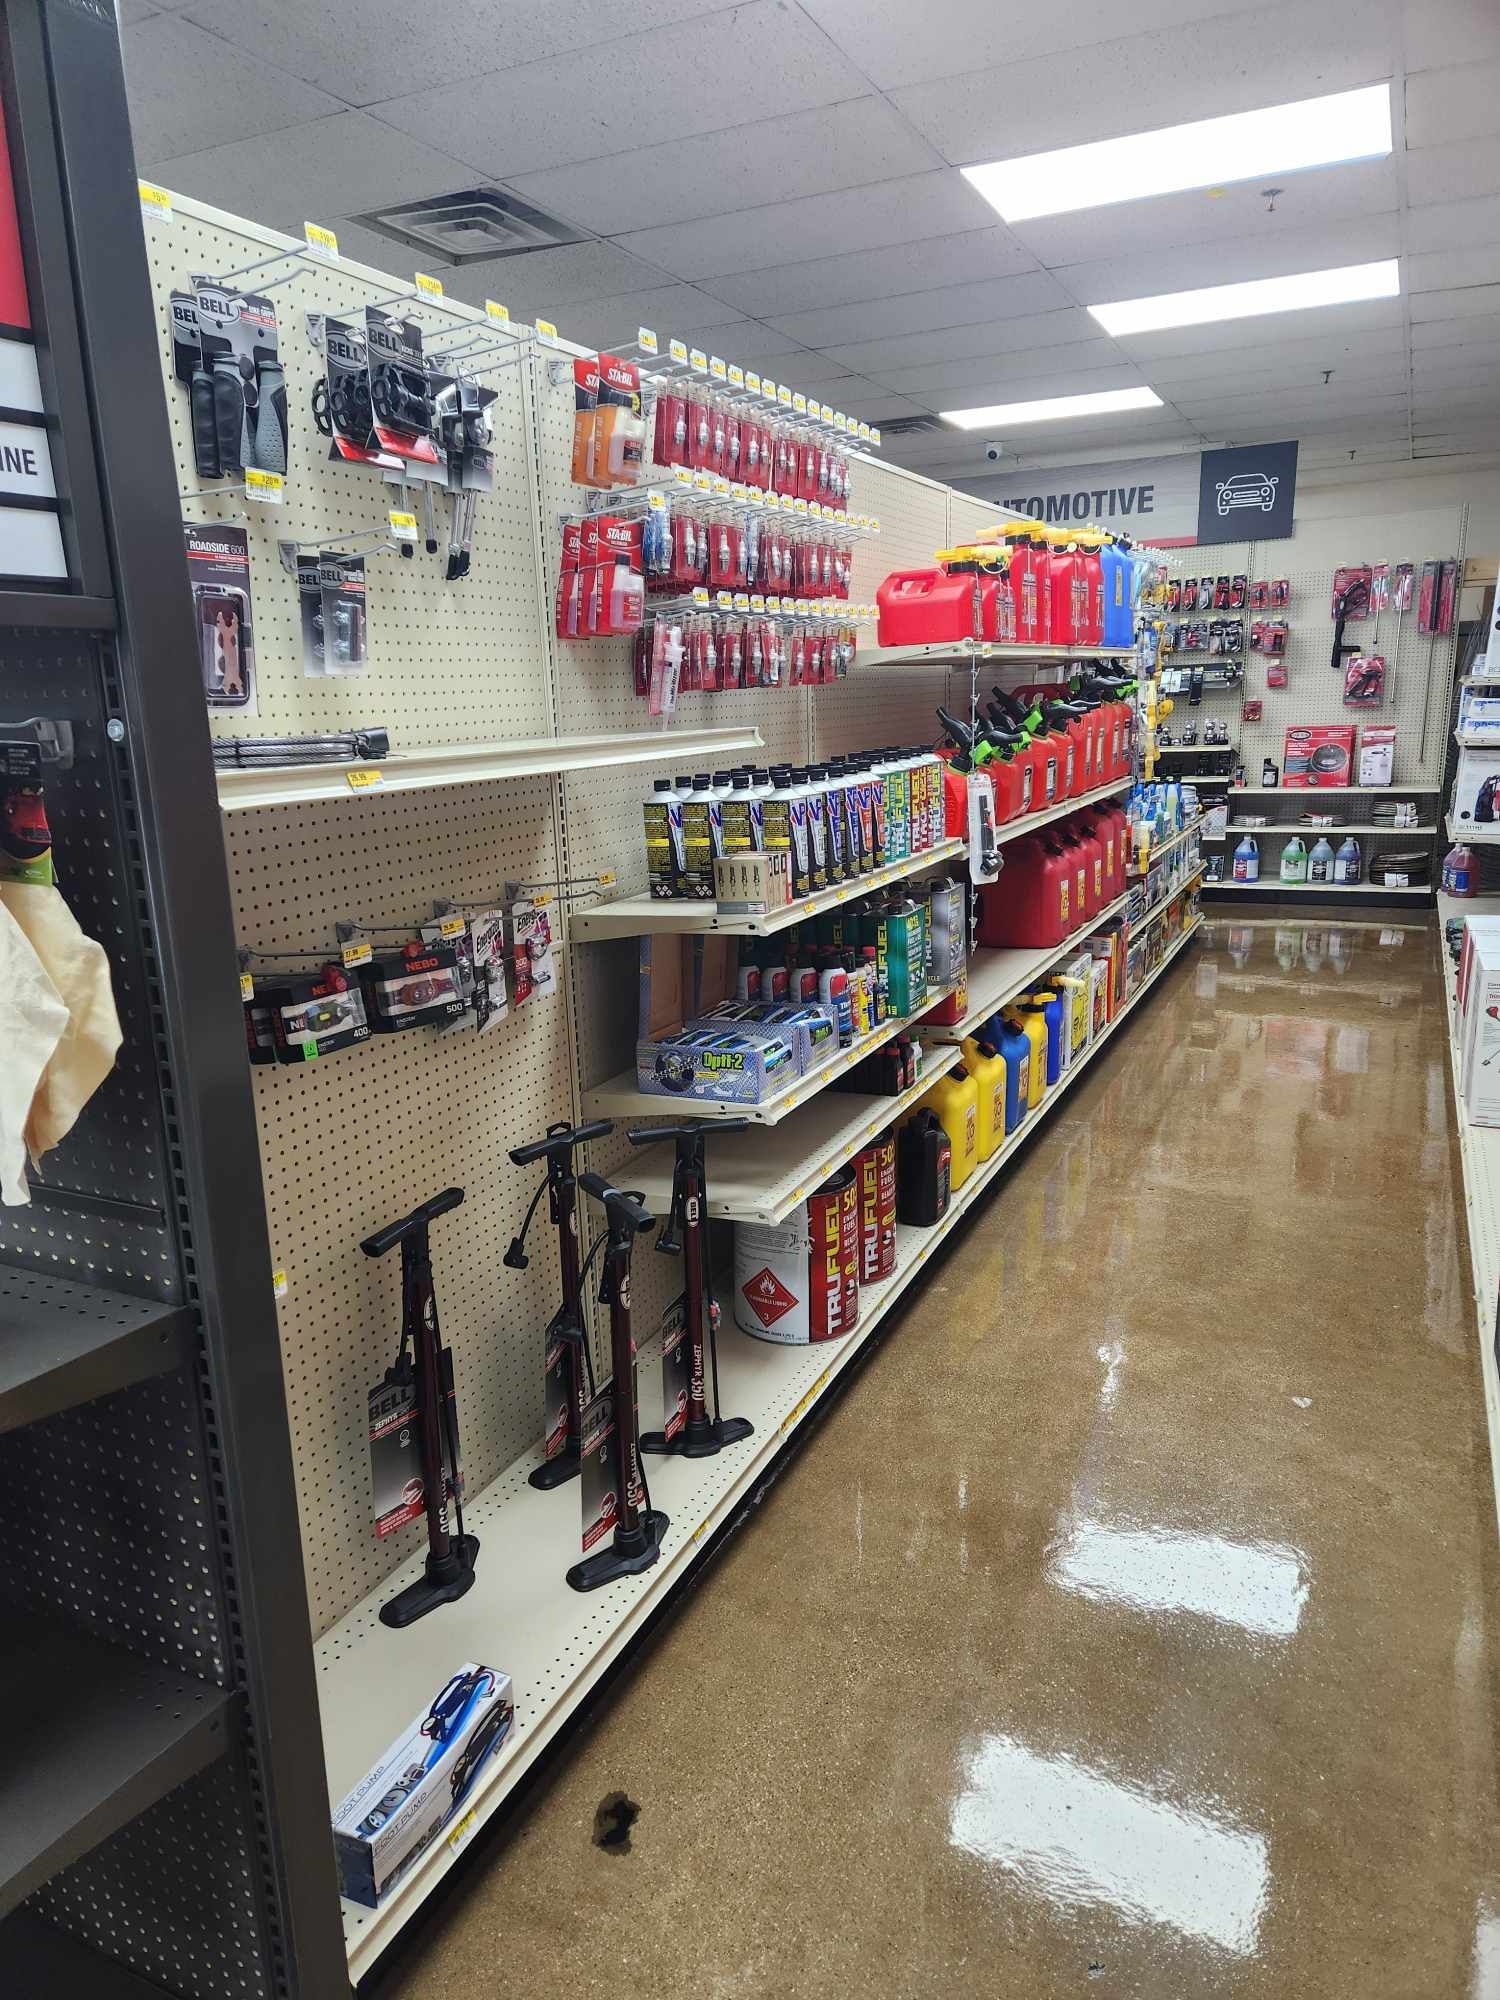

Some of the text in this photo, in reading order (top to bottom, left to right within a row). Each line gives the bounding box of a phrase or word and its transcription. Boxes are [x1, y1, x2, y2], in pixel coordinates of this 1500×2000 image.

[173, 305, 199, 325] BEL
[198, 296, 234, 317] BELL
[327, 339, 359, 361] BELL
[368, 328, 400, 353] BELL
[994, 485, 1155, 522] TOMOTIVE
[189, 540, 230, 554] ROADSIDE
[299, 574, 320, 586] BEL
[320, 570, 343, 582] BELL
[858, 787, 872, 809] VP
[791, 802, 806, 827] VP
[405, 958, 439, 972] NEBO
[446, 1002, 463, 1013] 500
[353, 1026, 369, 1038] 400
[703, 1051, 744, 1072] Opti-2
[863, 1151, 879, 1280] TRUFUEL
[827, 1197, 842, 1335] TRUFUEL
[763, 1312, 769, 1320] 3
[691, 1344, 705, 1401] ZEPHYR 350
[369, 1388, 412, 1419] BELL
[357, 1765, 386, 1802] PUMP
[374, 1789, 431, 1856] FOOT PUMP
